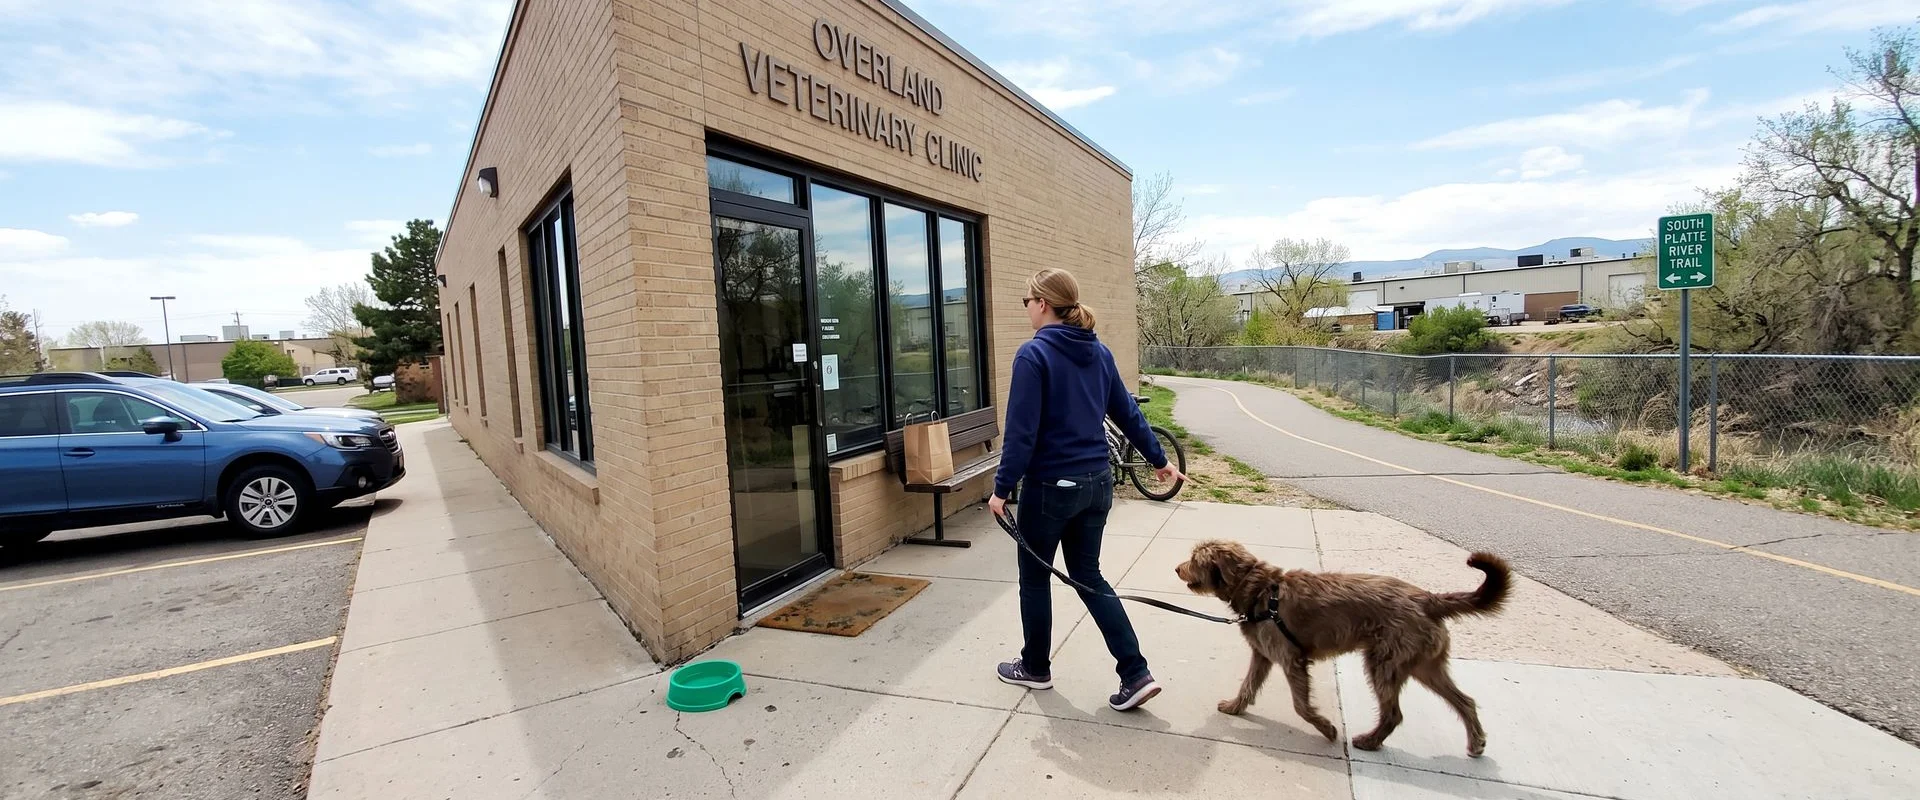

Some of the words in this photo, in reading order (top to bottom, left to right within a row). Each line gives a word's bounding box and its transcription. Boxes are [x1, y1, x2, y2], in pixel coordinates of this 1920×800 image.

[813, 17, 944, 116] OVERLAND
[739, 42, 916, 156] VETERINARY
[926, 130, 983, 182] CLINIC
[1667, 218, 1703, 231] SOUTH
[1664, 231, 1707, 244] PLATTE
[1669, 244, 1702, 256] RIVER
[1670, 257, 1702, 269] TRAIL
